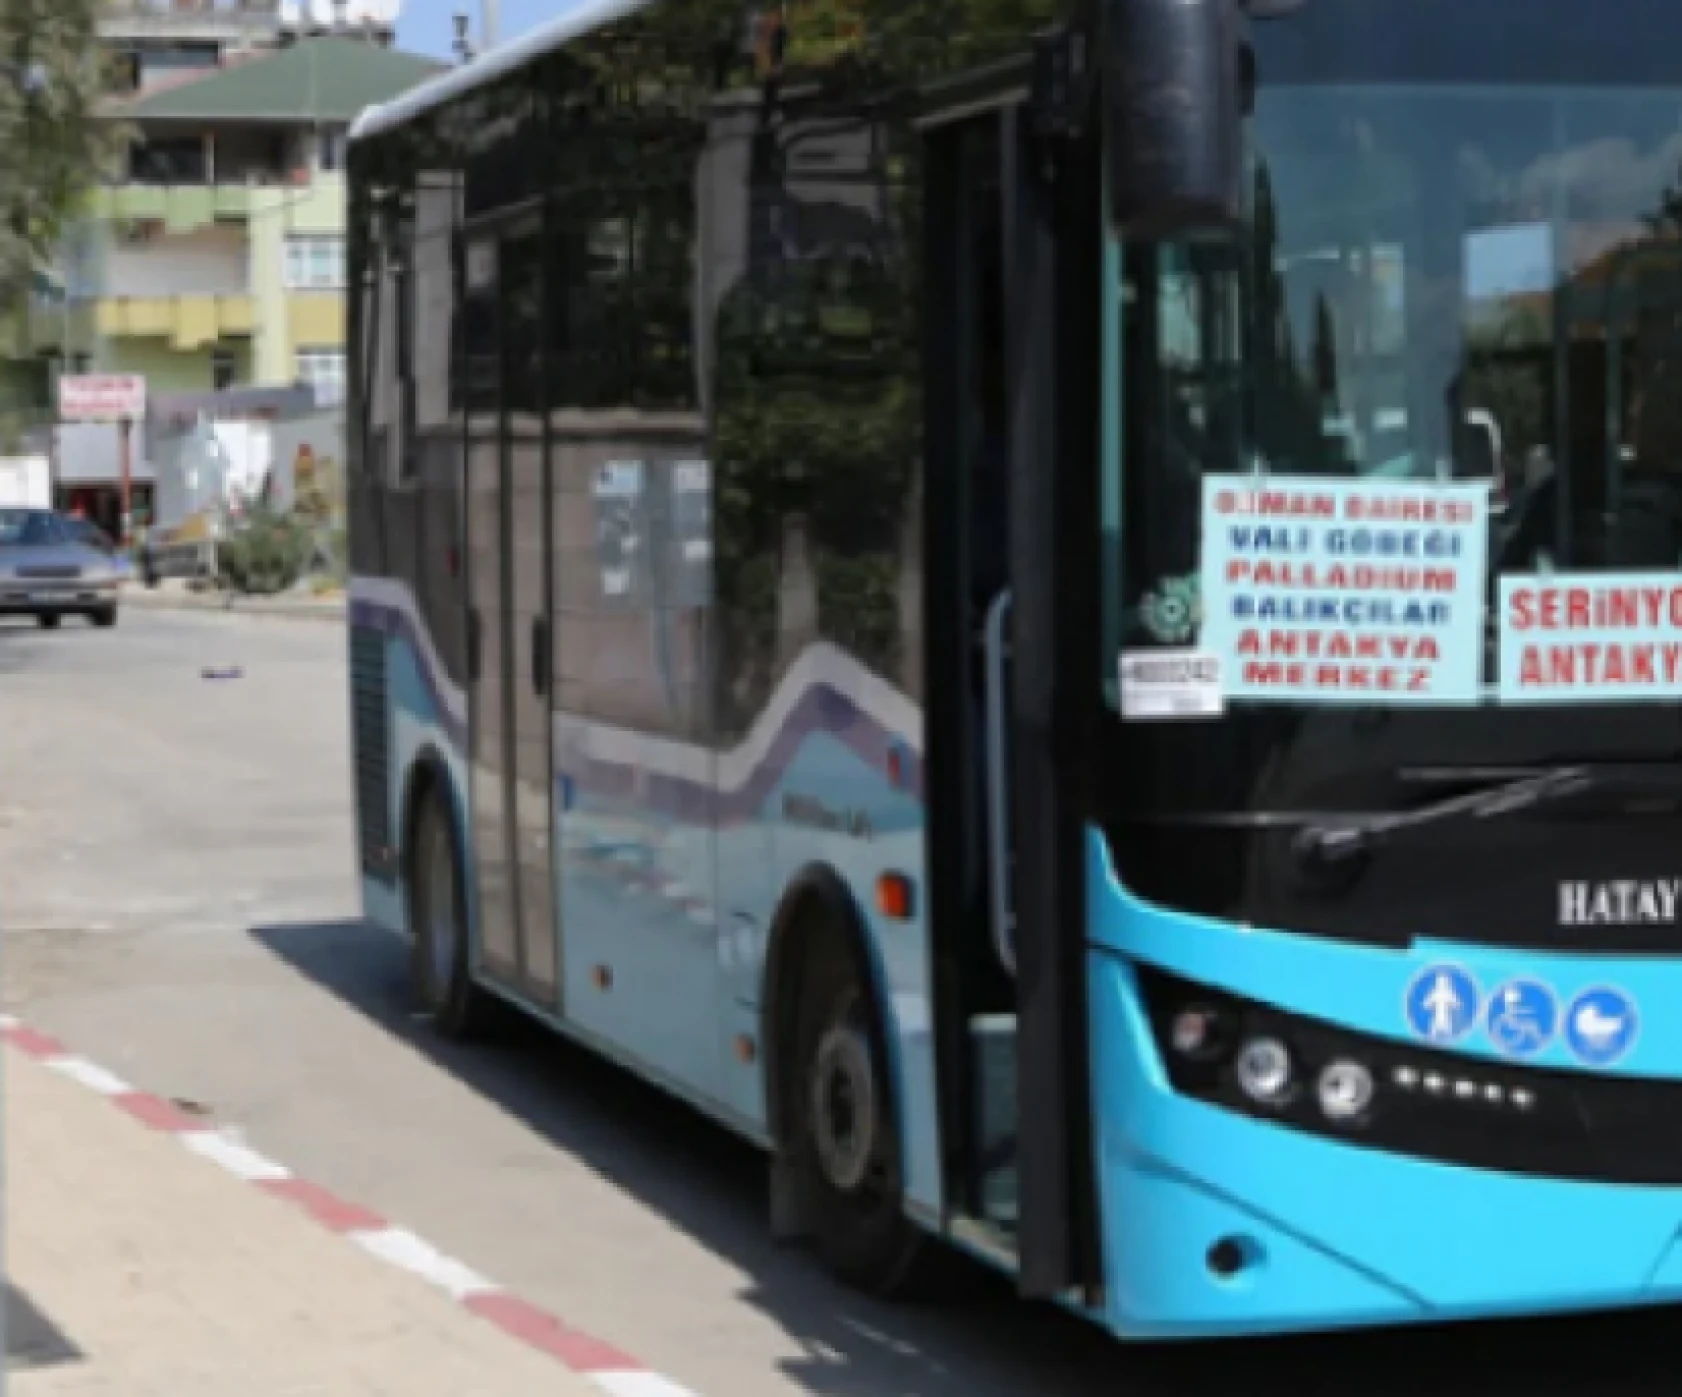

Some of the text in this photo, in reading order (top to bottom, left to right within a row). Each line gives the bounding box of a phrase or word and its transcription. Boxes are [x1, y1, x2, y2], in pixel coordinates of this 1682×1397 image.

[1224, 558, 1457, 591] PALLADIUM
[1235, 627, 1440, 661] ANTAKYA
[1242, 661, 1432, 690] MERKEZ
[1558, 877, 1682, 925] HATAY
